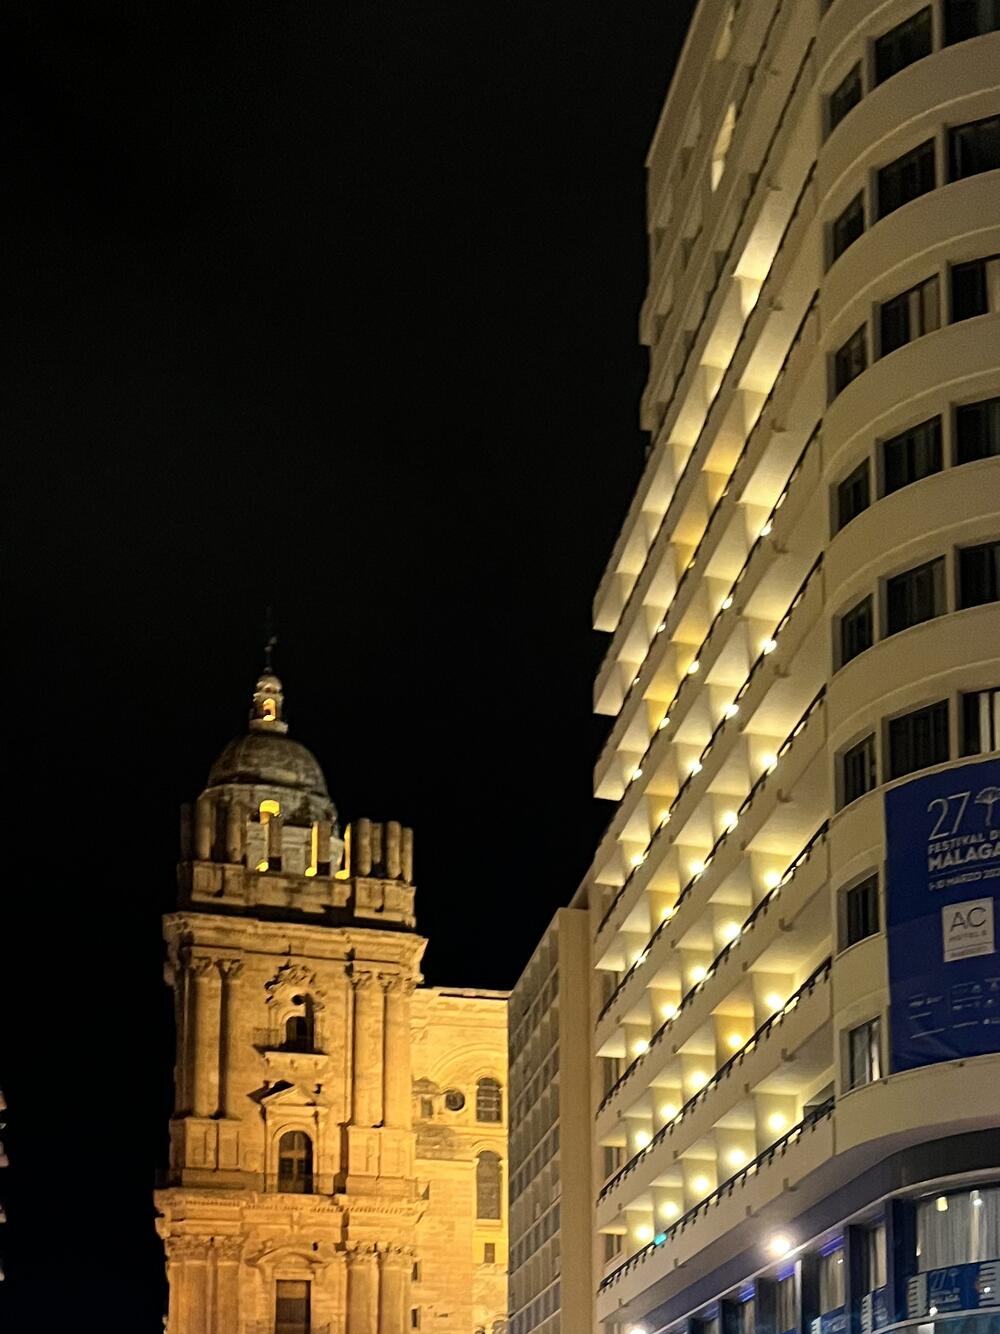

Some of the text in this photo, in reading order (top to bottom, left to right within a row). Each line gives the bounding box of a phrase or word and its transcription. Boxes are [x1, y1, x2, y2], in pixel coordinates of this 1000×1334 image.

[927, 791, 971, 841] 27
[928, 833, 986, 855] FESTIVAL
[950, 906, 986, 932] AC
